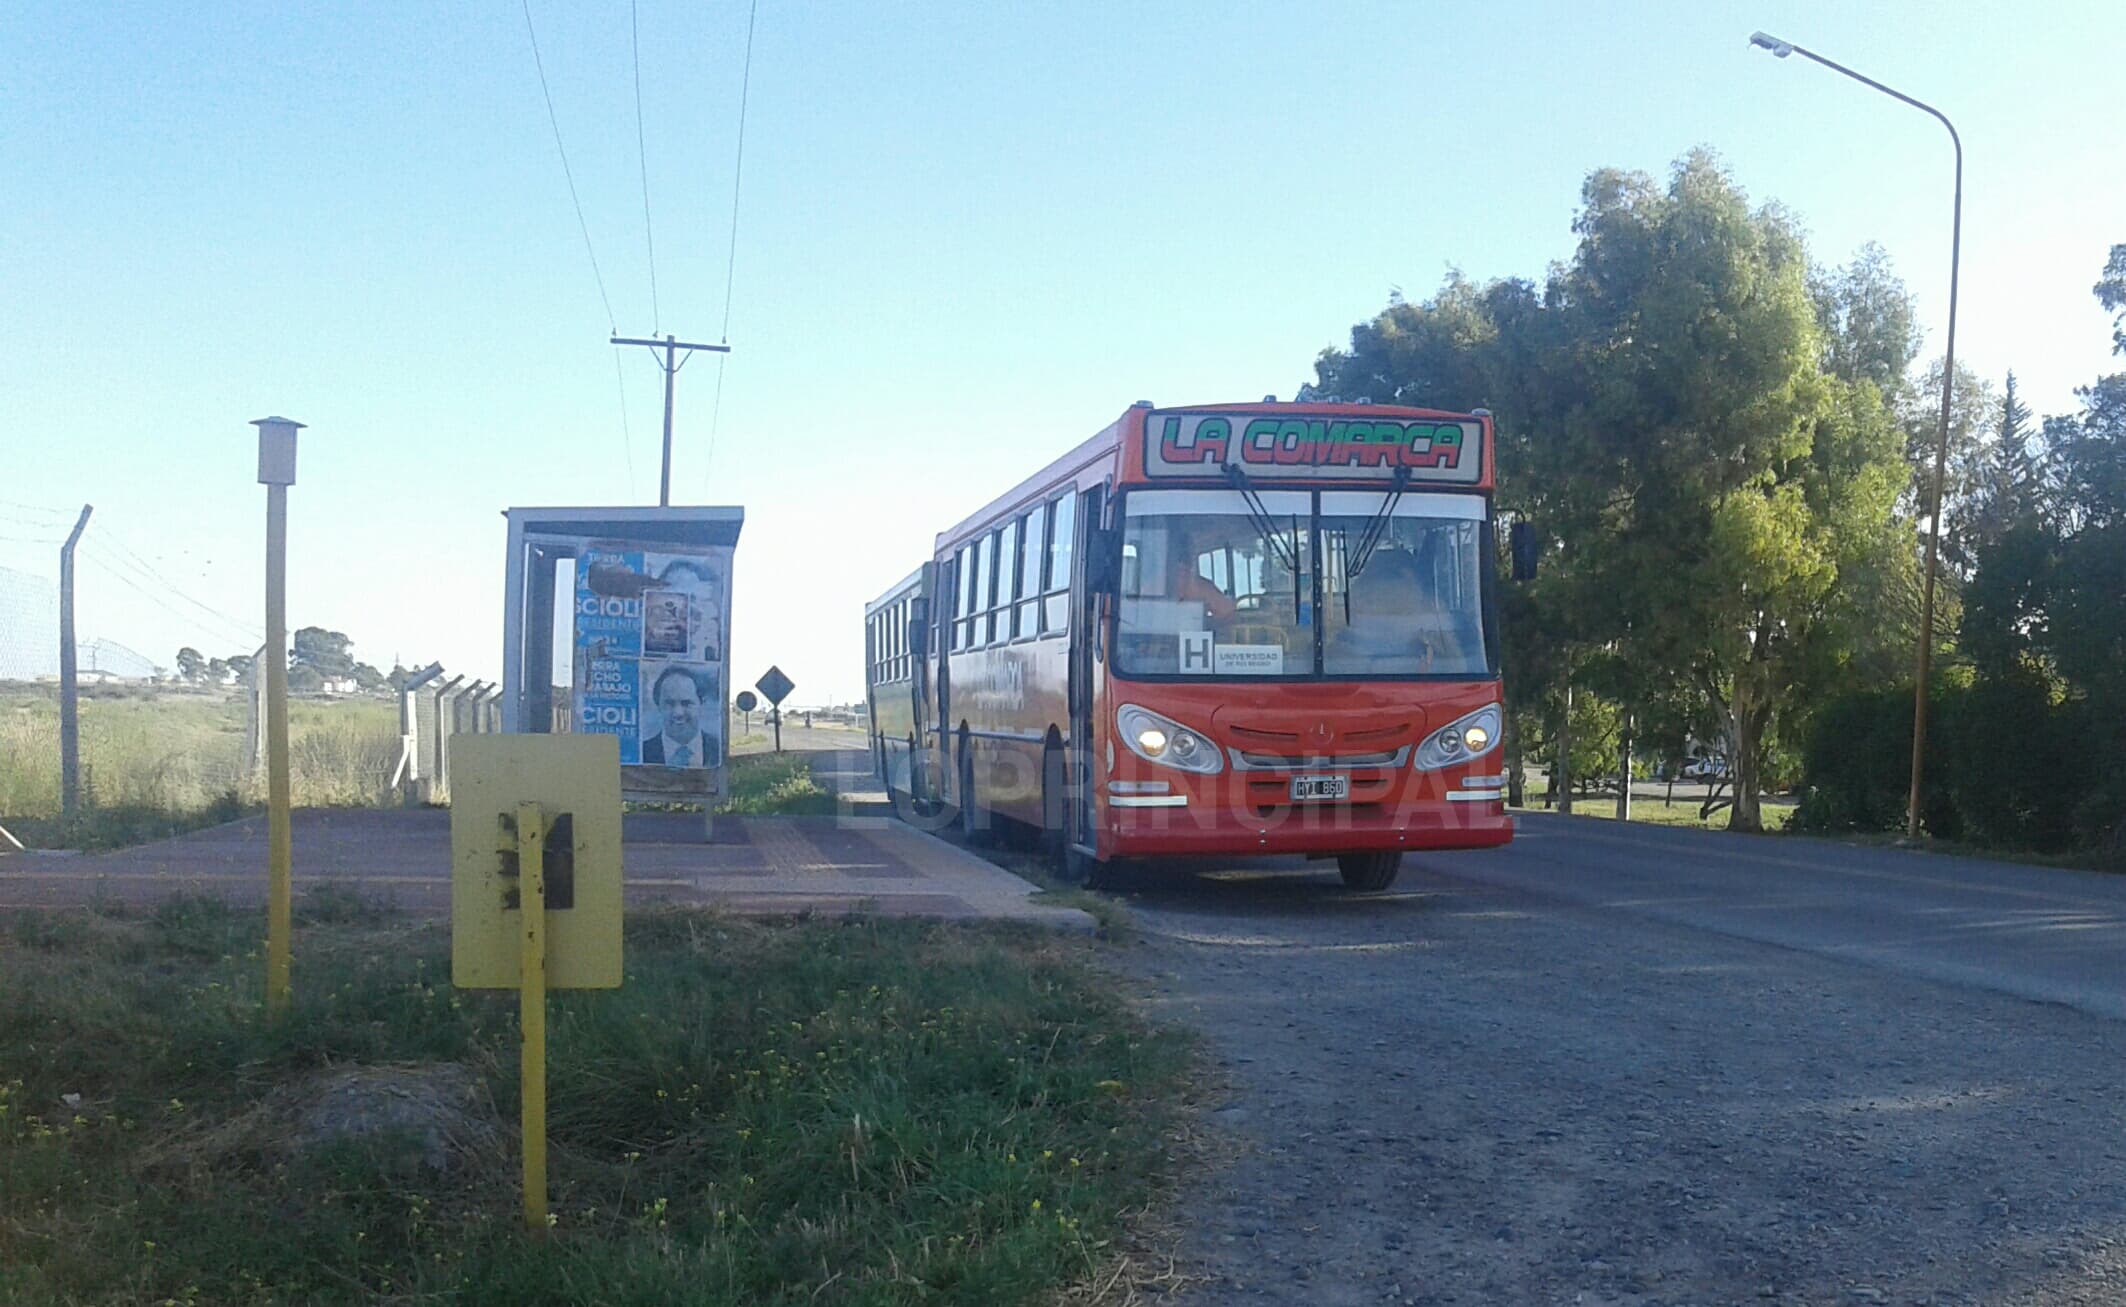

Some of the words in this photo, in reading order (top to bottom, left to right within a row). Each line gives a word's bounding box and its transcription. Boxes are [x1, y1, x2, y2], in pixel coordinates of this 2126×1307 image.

[1161, 417, 1232, 464] LA
[1241, 419, 1464, 468] COMARCA
[1185, 638, 1209, 668] H
[1220, 653, 1278, 661] UNIVERSIDAD
[583, 706, 637, 725] CIOLI
[1298, 782, 1317, 795] HYI
[1323, 781, 1342, 794] 860
